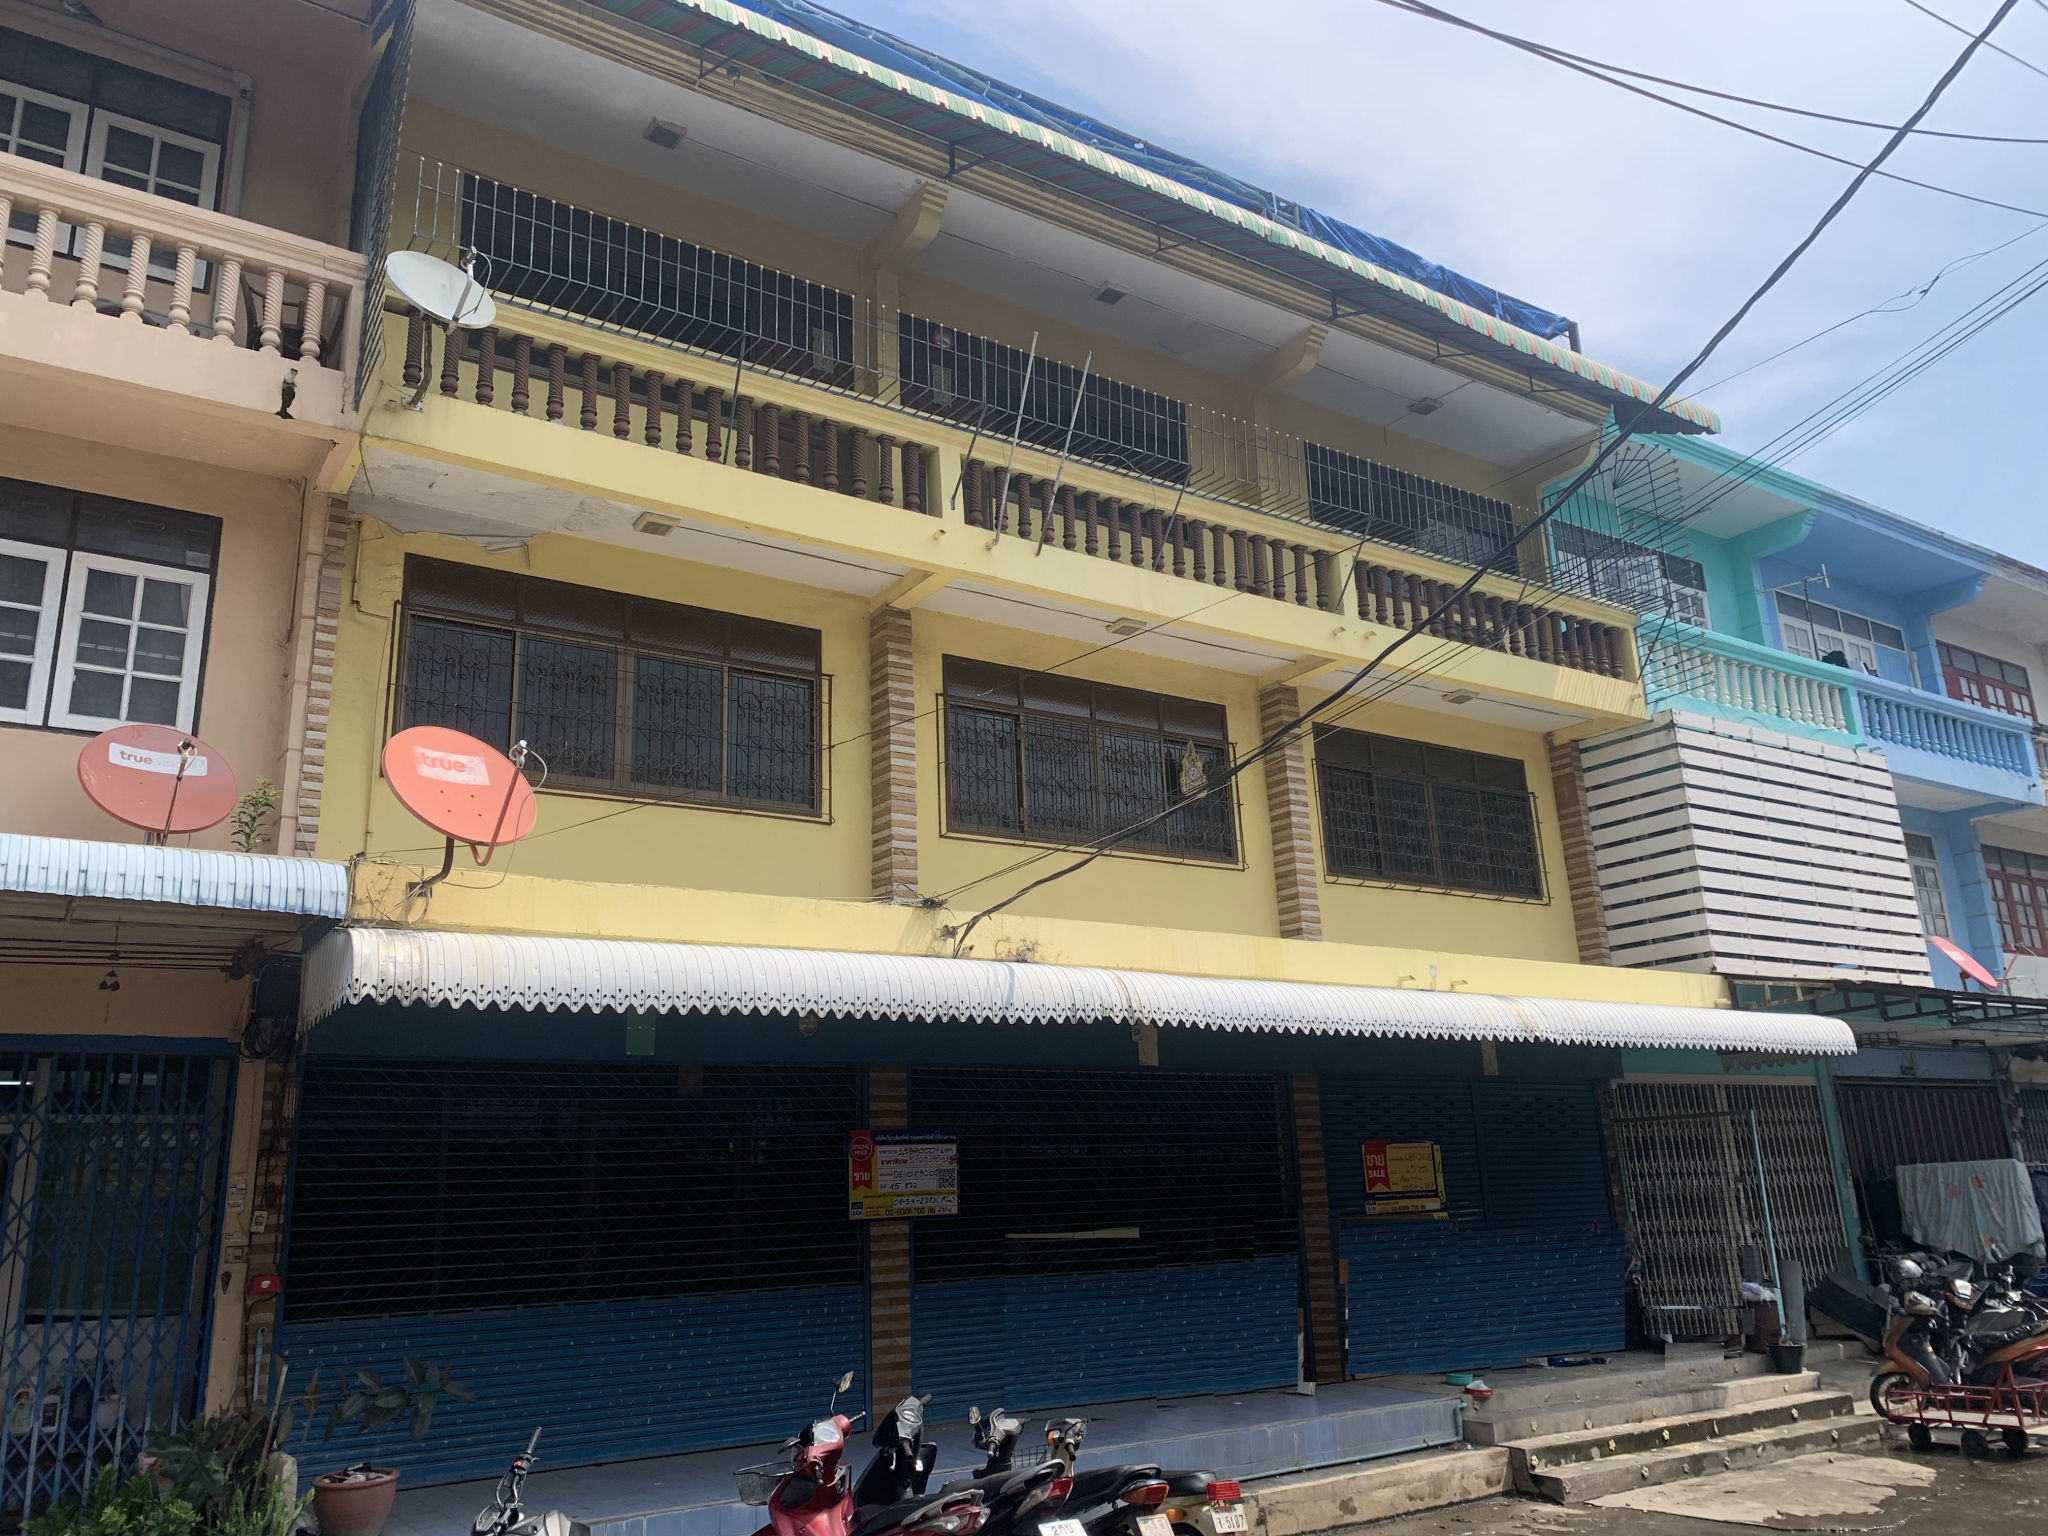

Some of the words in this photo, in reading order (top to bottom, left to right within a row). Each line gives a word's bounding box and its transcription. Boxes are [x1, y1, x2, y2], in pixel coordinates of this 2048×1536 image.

[120, 750, 153, 765] true
[420, 752, 467, 773] true
[1368, 1169, 1386, 1178] SALE
